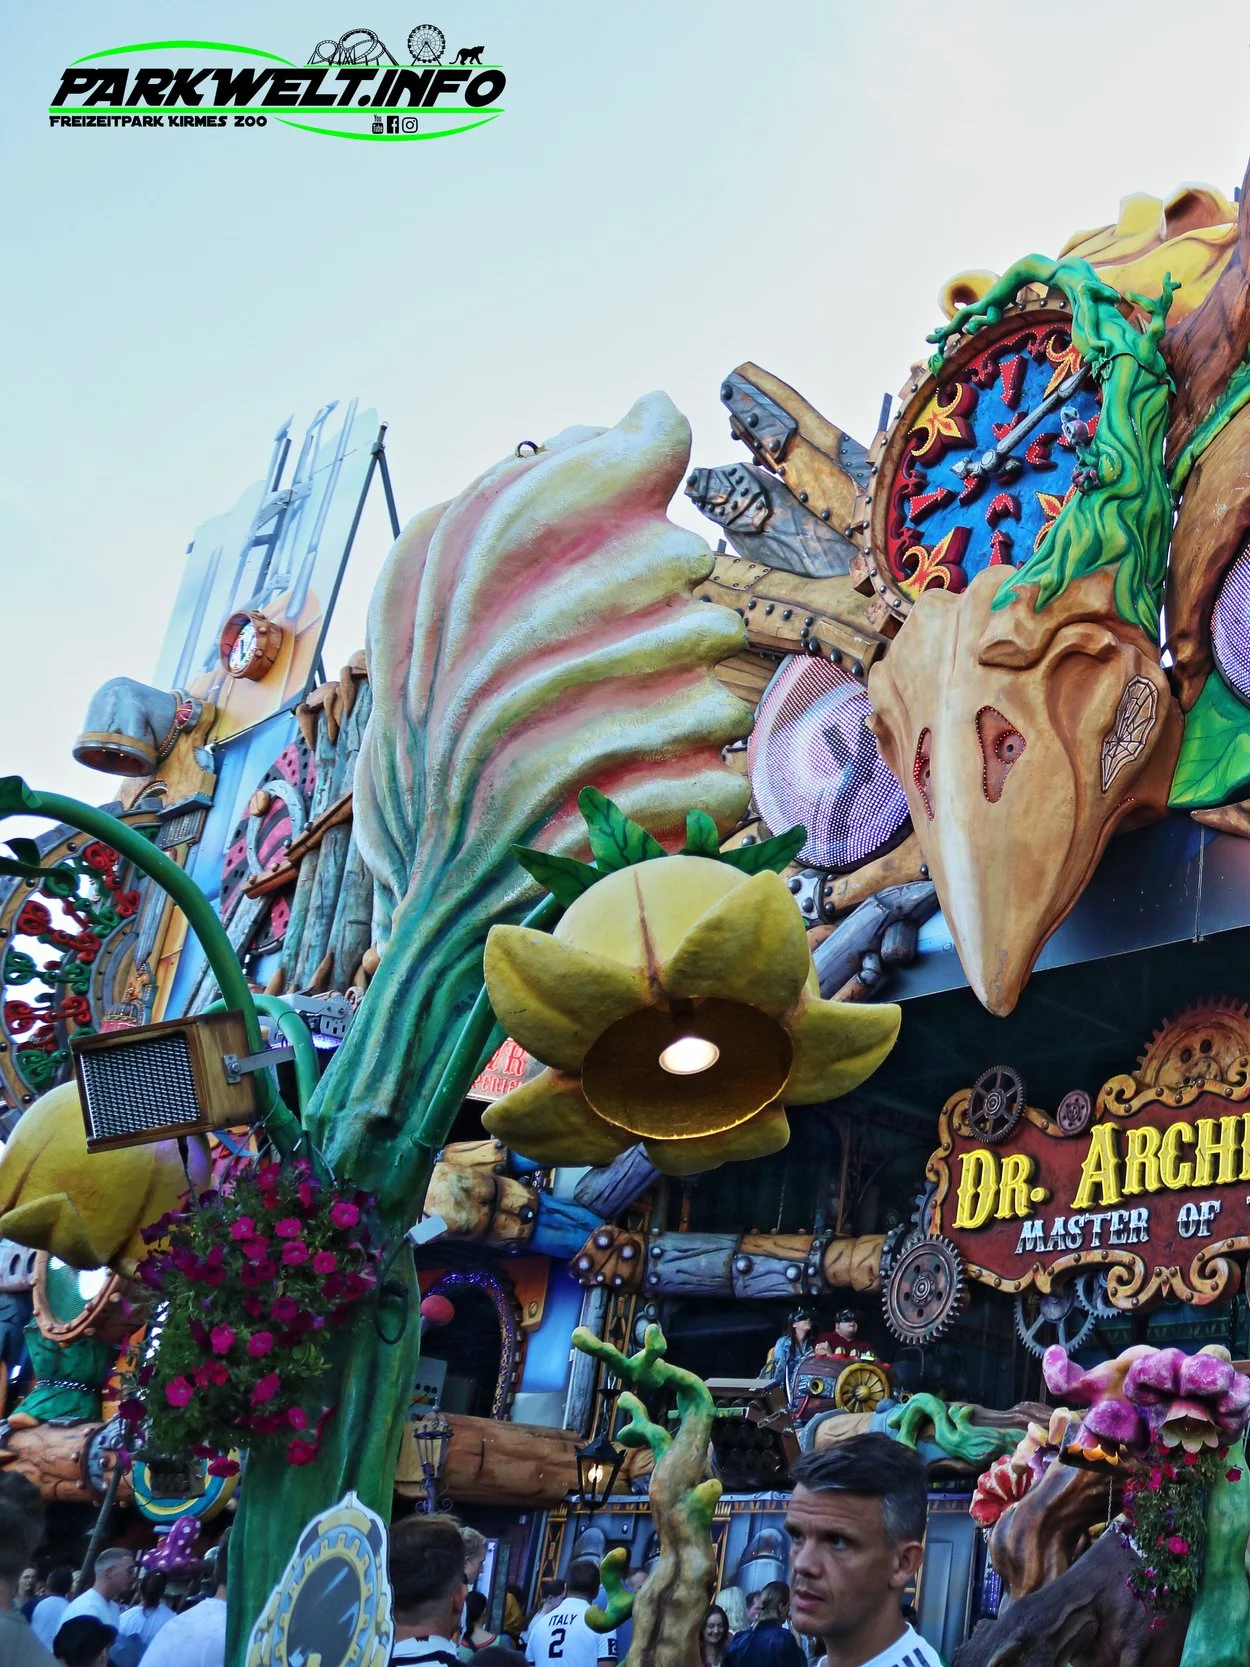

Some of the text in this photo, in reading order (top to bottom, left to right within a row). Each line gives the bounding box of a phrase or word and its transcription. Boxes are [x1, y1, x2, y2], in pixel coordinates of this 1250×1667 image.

[1014, 1206, 1150, 1255] MASTER
[1176, 1200, 1221, 1239] OF
[548, 1614, 577, 1626] ITALY
[548, 1627, 566, 1658] 2
